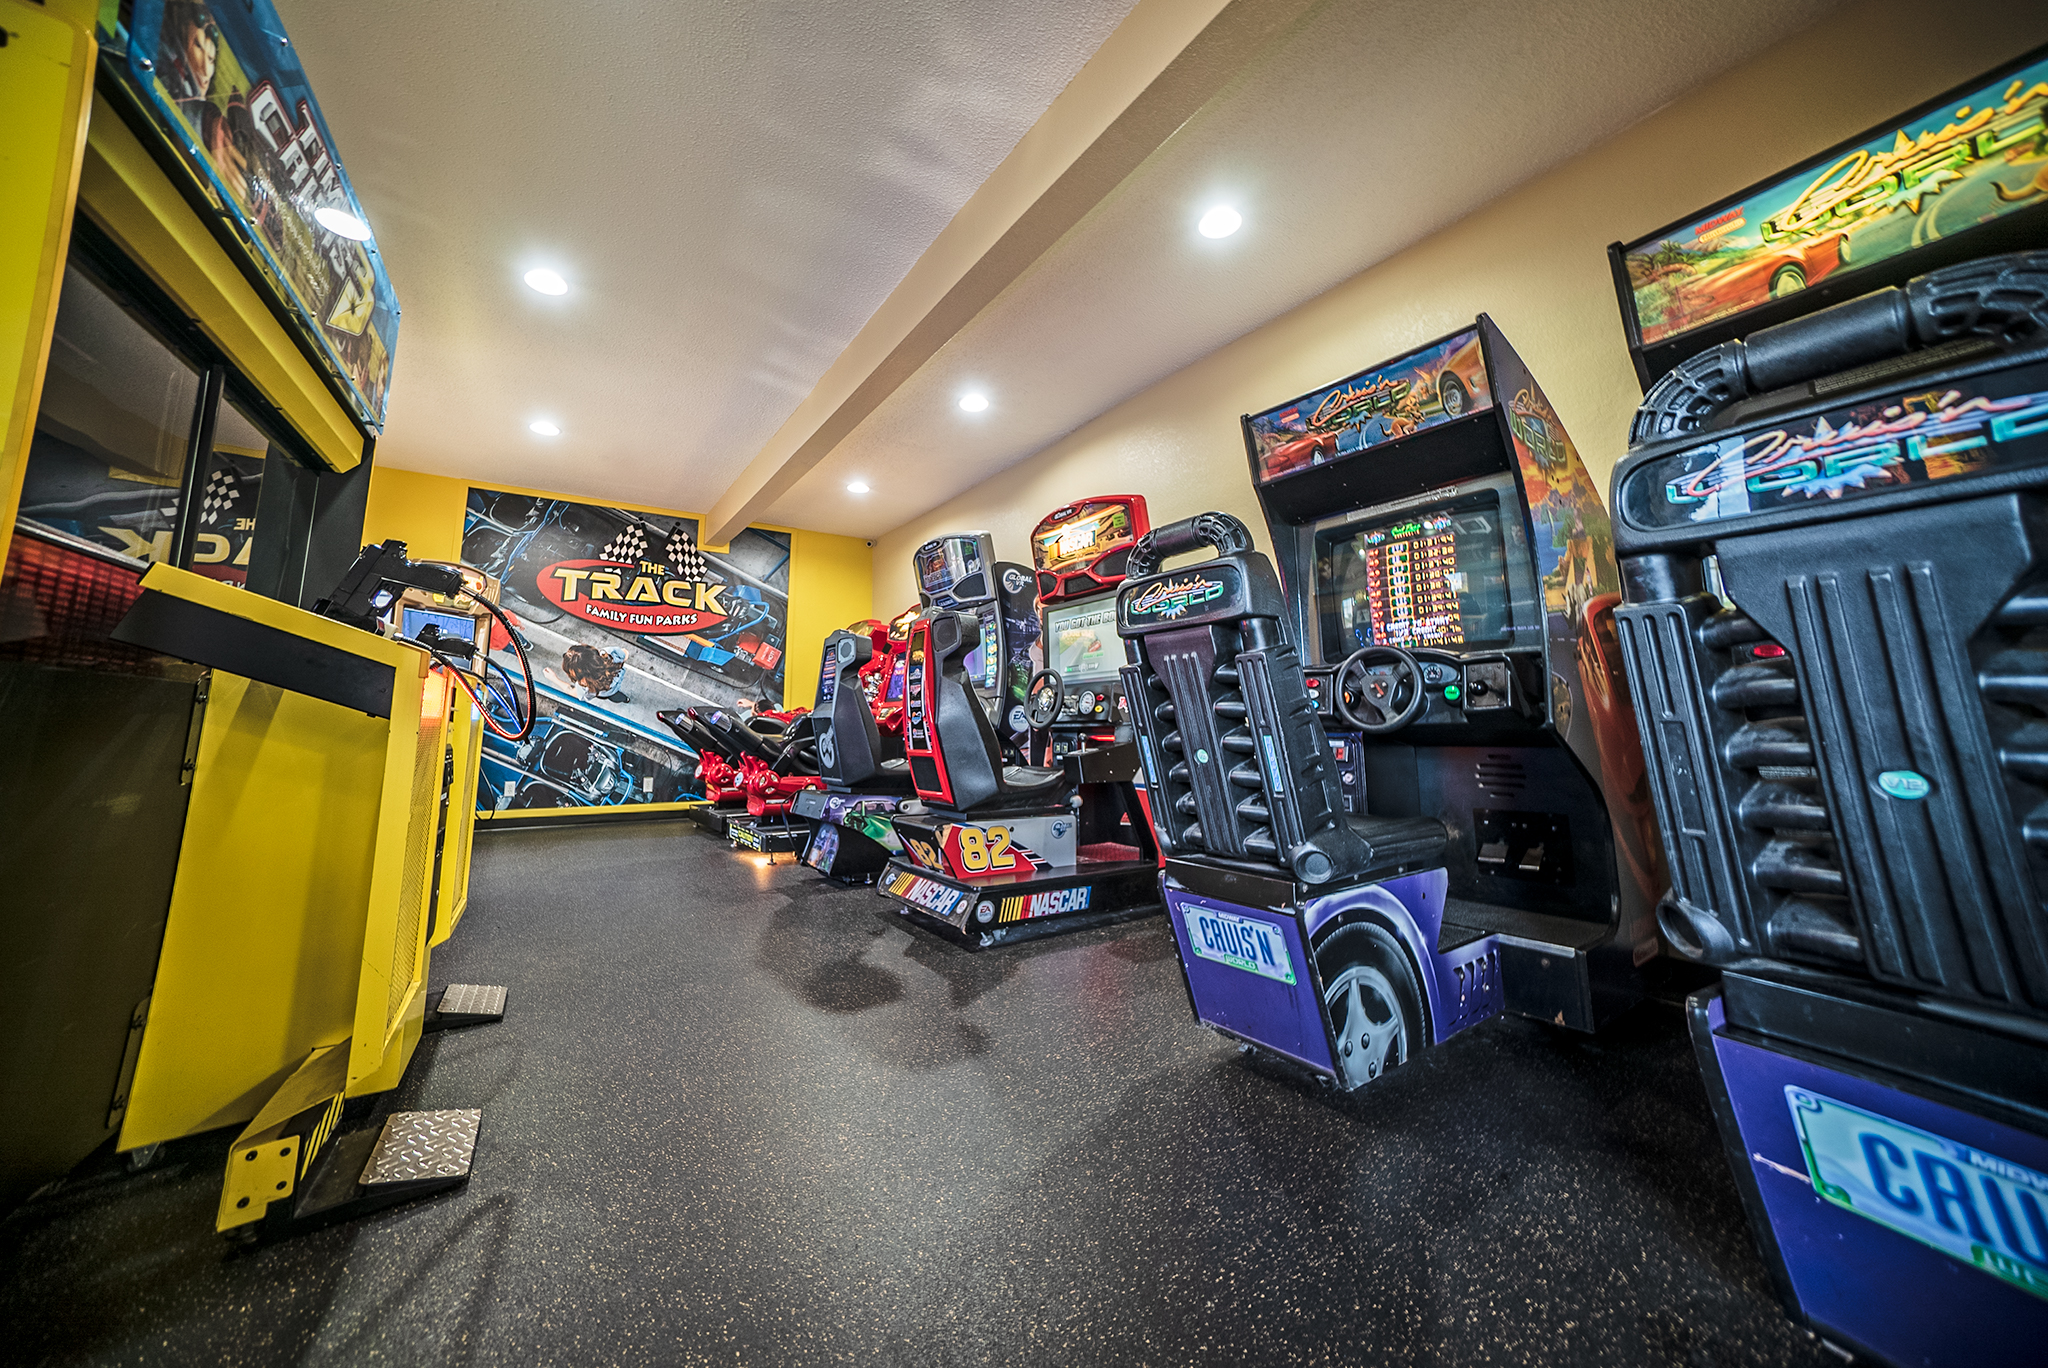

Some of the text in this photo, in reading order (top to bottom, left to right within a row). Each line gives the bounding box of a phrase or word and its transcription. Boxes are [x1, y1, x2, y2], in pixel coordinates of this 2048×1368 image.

[1694, 206, 1744, 236] MIDWAY
[639, 560, 665, 576] THE
[554, 567, 728, 617] TRACK
[585, 603, 698, 627] FAMILY FUN PARKS
[1886, 772, 1926, 791] V12
[908, 838, 944, 870] 82
[959, 825, 1017, 872] 82
[908, 878, 960, 915] NASCAR
[980, 905, 991, 913] EA
[1028, 887, 1089, 918] NASCAR
[1198, 916, 1276, 967] CRUIS'N
[1225, 955, 1256, 970] WORLD
